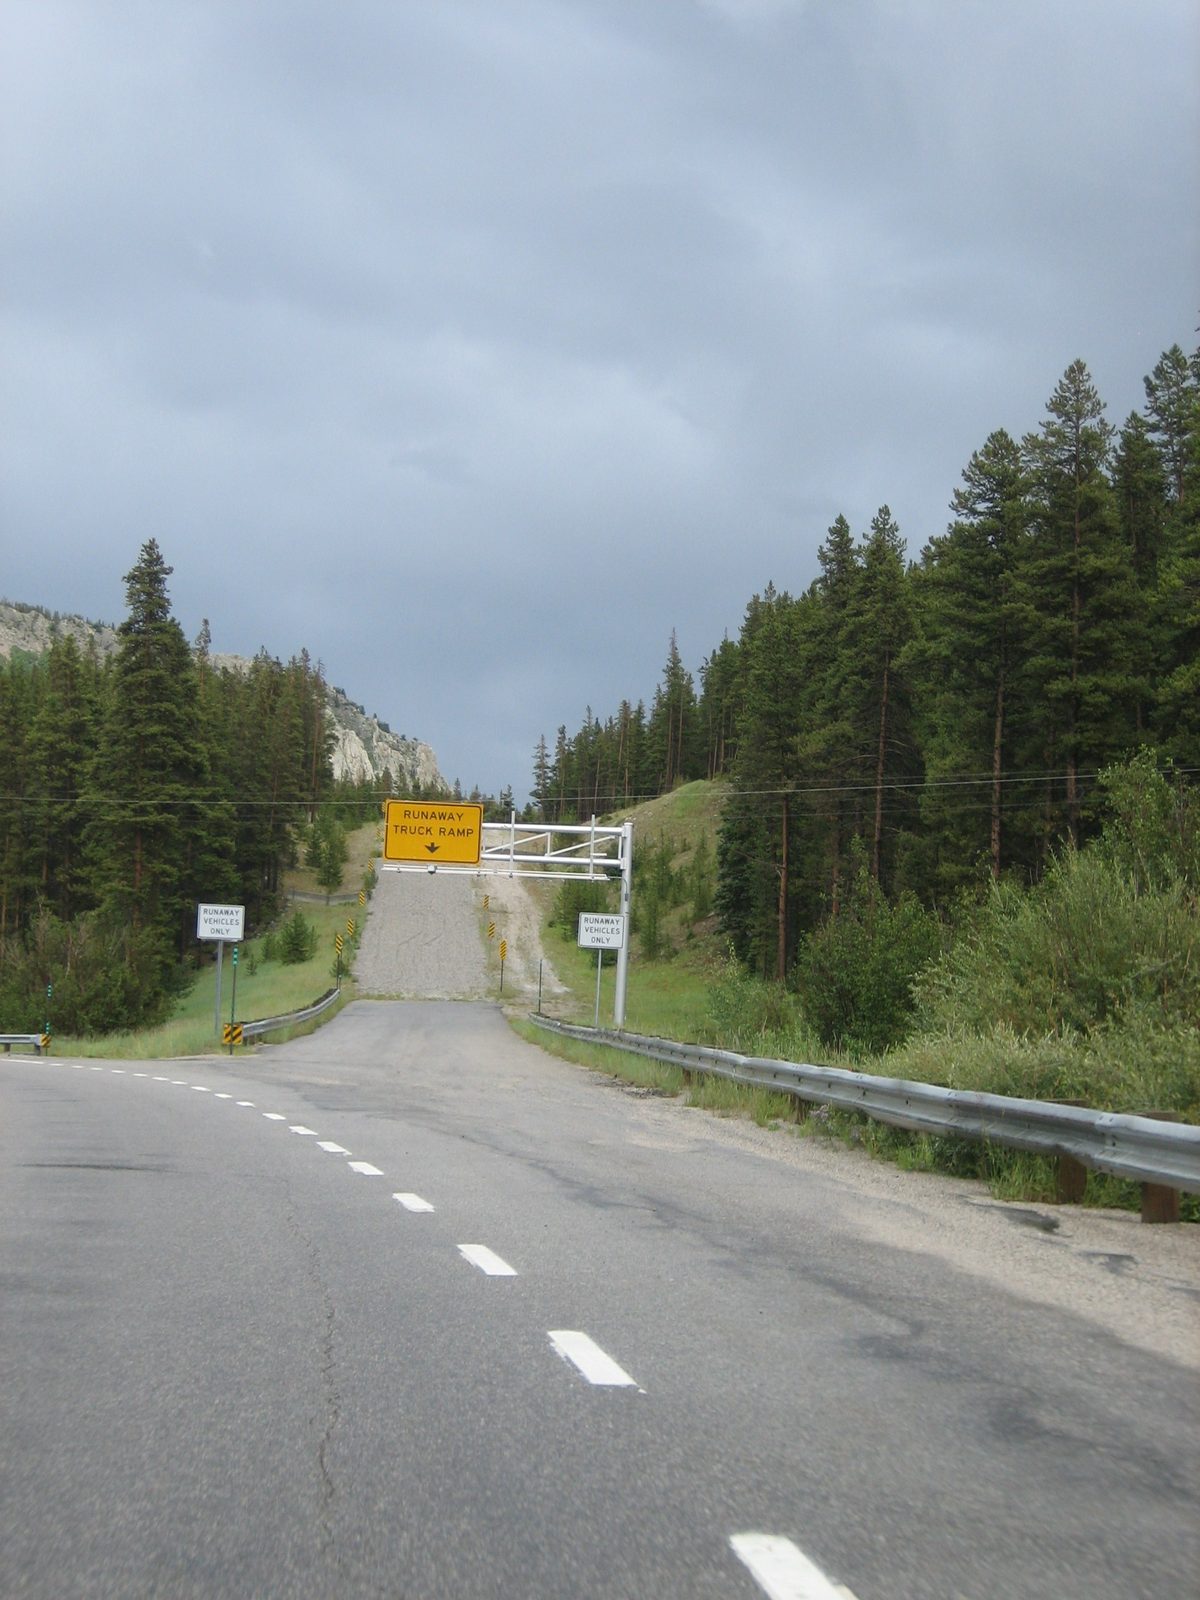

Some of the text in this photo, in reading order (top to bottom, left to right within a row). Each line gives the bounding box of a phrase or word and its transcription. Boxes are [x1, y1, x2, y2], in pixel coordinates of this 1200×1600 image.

[404, 810, 464, 821] RUNAWAY
[393, 825, 474, 837] TRUCK RAMP
[203, 908, 240, 916] RUNAWAY
[203, 917, 240, 926] VEHICLES
[584, 917, 620, 925] RUNAWAY
[210, 927, 230, 935] ONLY
[584, 926, 621, 935] VEHICLES
[591, 936, 611, 944] ONLY
